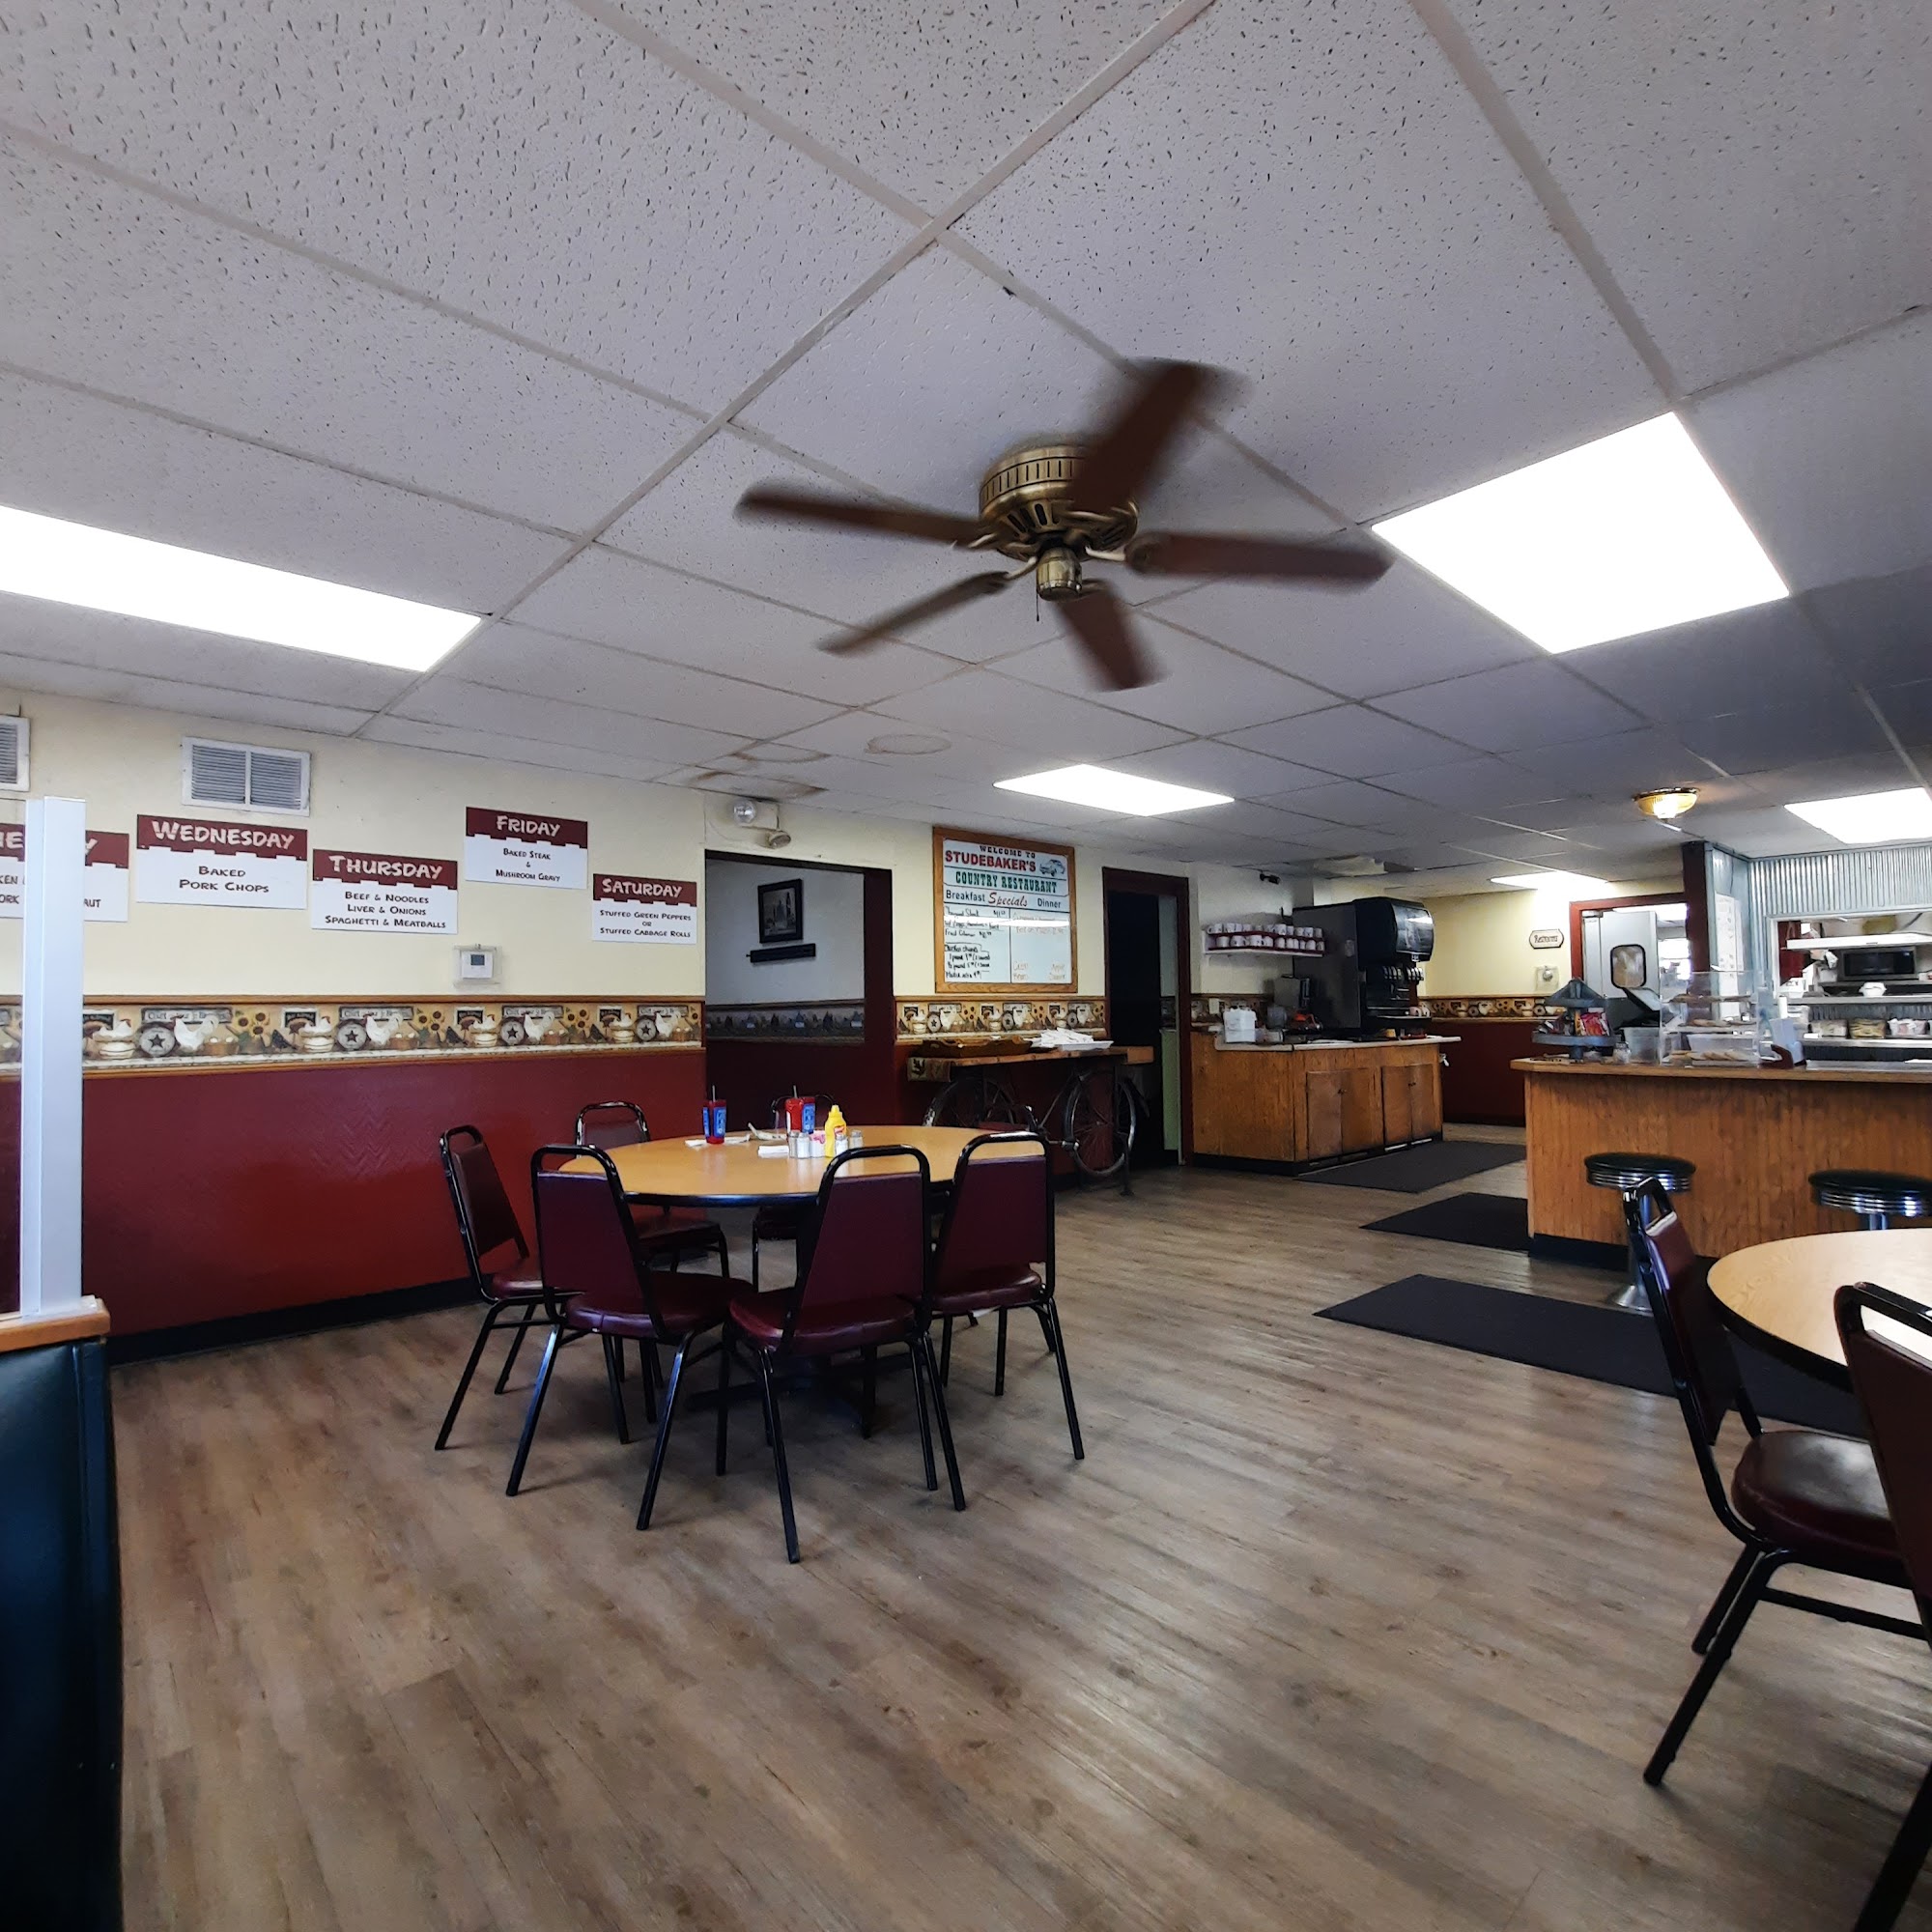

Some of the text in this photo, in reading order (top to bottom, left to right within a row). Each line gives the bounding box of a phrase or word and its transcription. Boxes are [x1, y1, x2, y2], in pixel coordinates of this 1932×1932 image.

[497, 815, 560, 837] FRIDAY
[151, 820, 295, 850] WEDNESDAY
[503, 847, 552, 861] BAKED STEAK
[980, 844, 1036, 860] WELCOME TO
[328, 855, 442, 880] THURSDAY
[945, 849, 1037, 873] STUDEBAKER'S
[198, 866, 246, 878] BAKED
[496, 868, 561, 883] MUSHROOM GRAVY
[180, 879, 270, 894] PORK CHOPS
[602, 878, 682, 897] SATURDAY
[955, 870, 1057, 894] COUNTRY RESTAURANT
[345, 892, 370, 902] BEEF
[385, 894, 430, 905] NOODLES
[946, 889, 985, 903] Breakfast
[987, 892, 1028, 907] Specials
[1037, 897, 1062, 909] Dinner
[347, 904, 427, 916] LIVER & ONIONS
[599, 909, 692, 923] STUFFED GREEN PEPPERS
[325, 915, 380, 926] SPAGHETTI
[393, 918, 446, 929] MEATBALLS
[599, 926, 692, 939] STUFFED CABBAGE ROLLS
